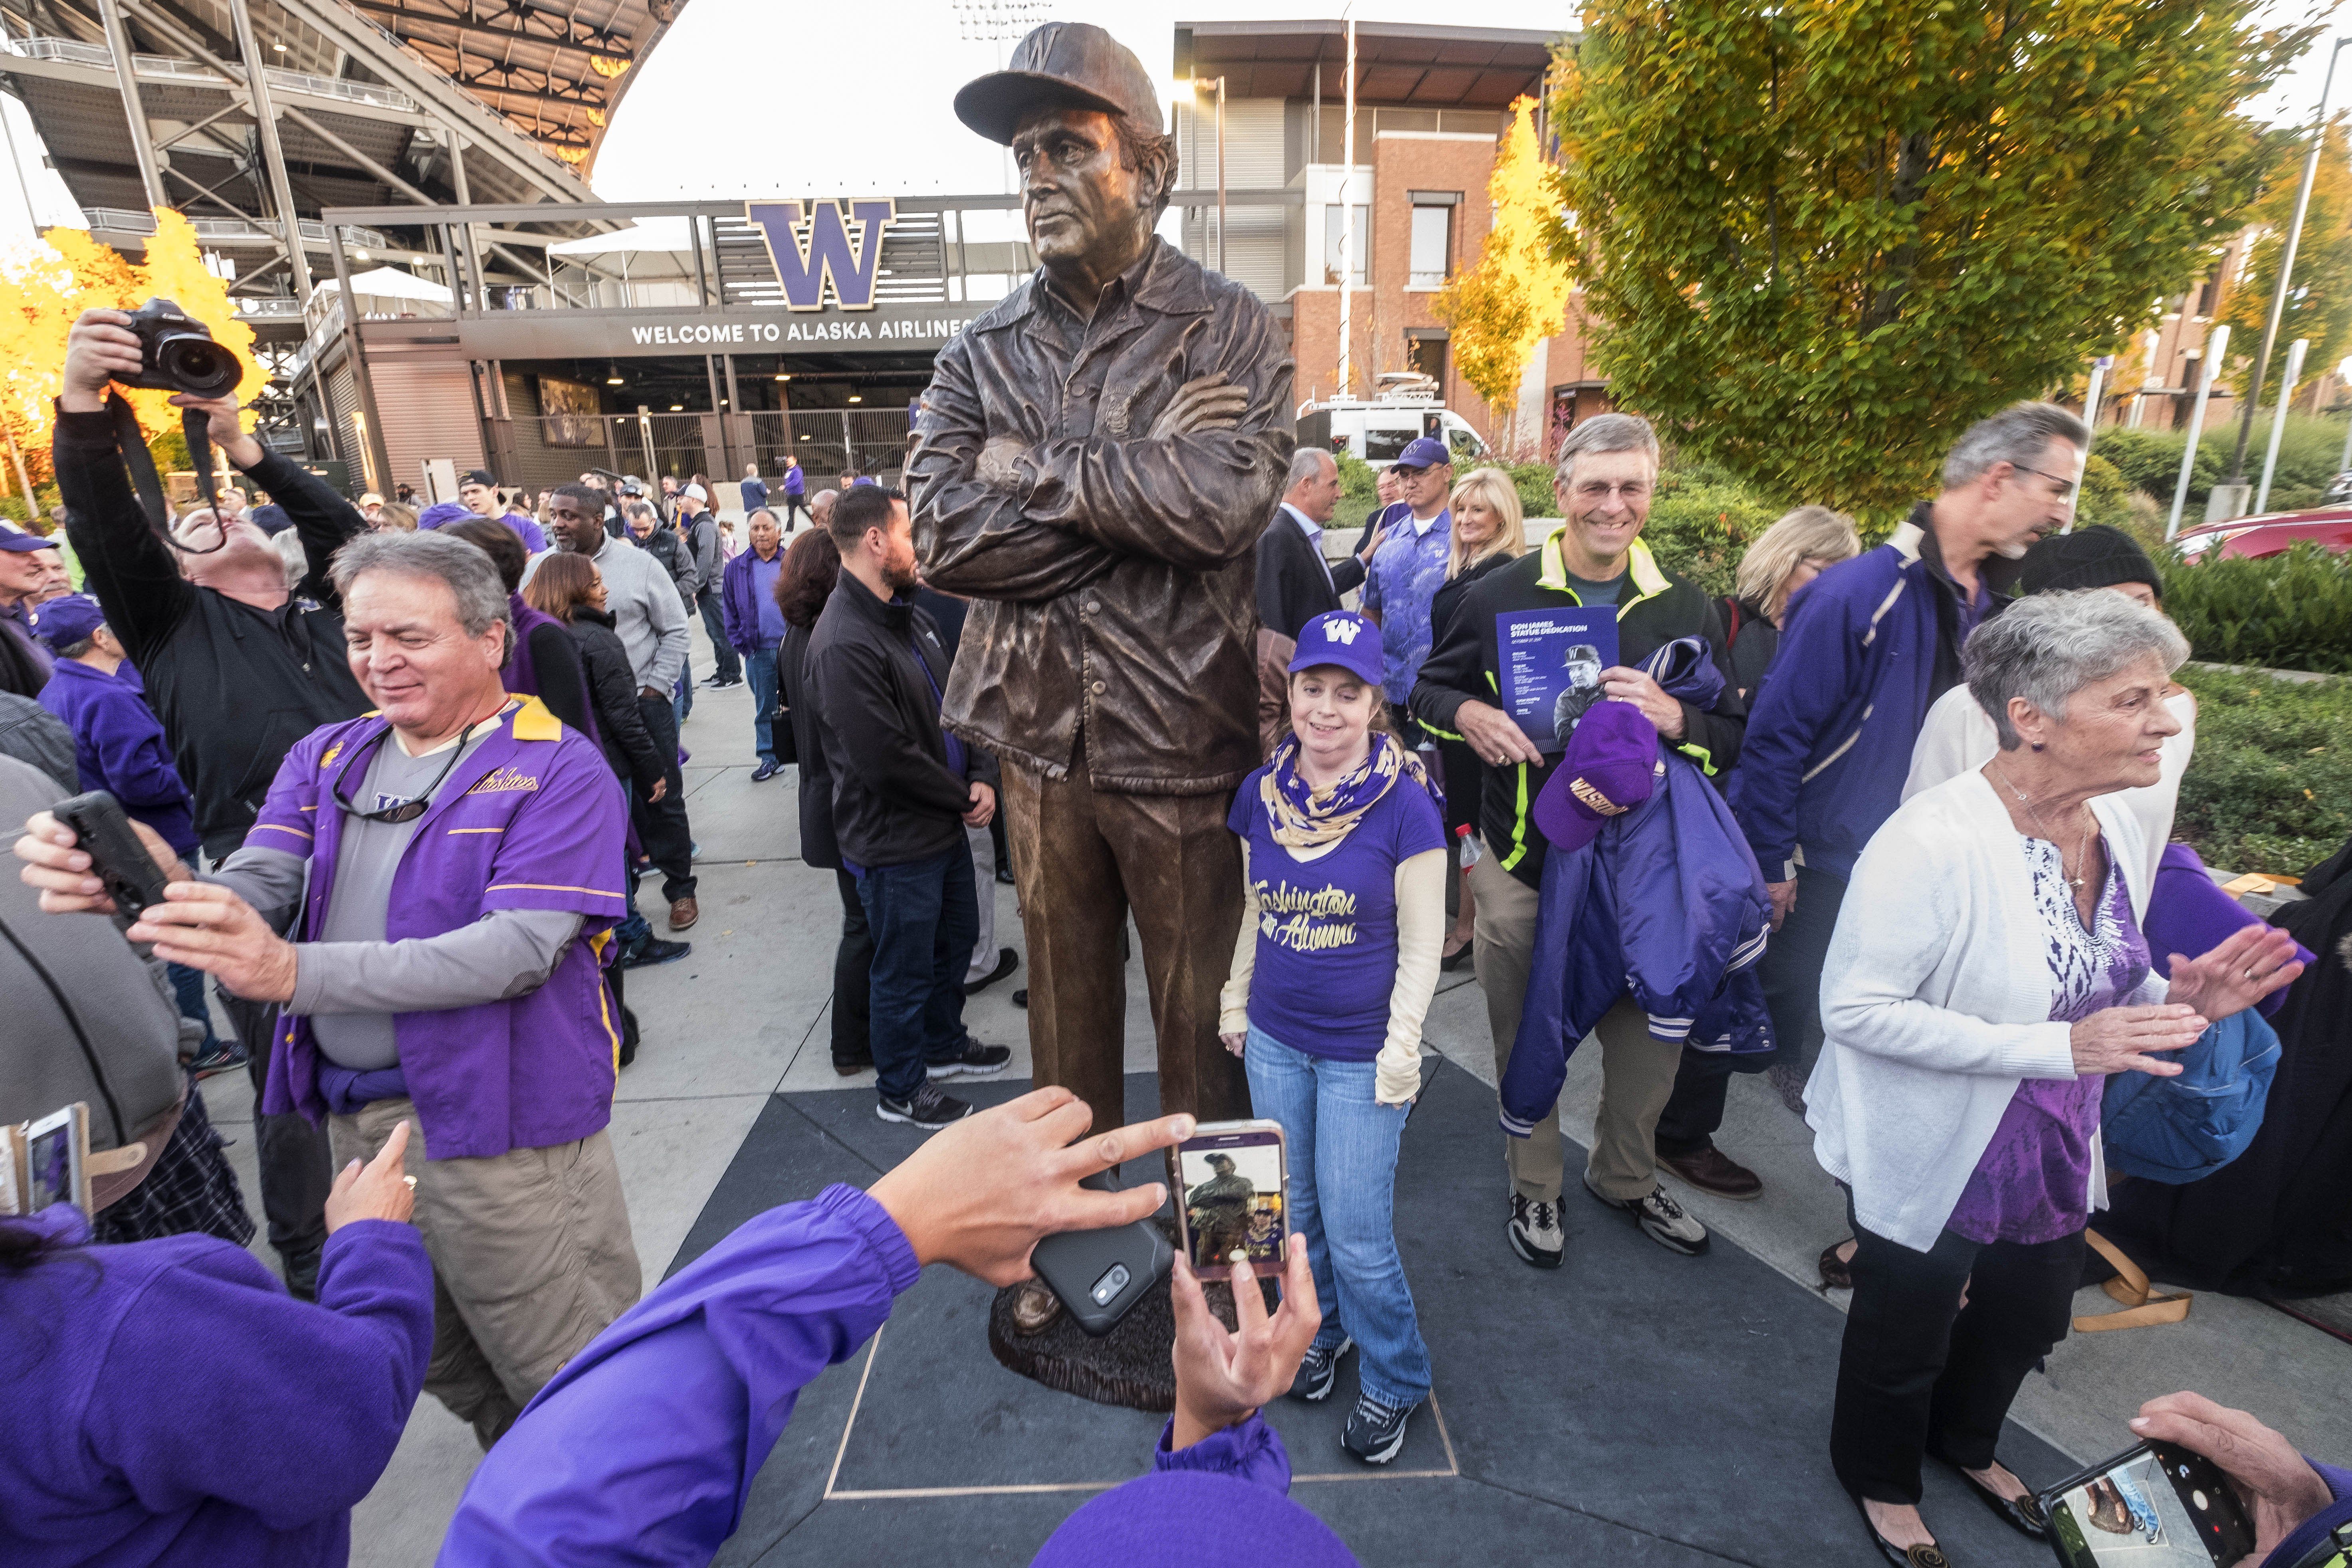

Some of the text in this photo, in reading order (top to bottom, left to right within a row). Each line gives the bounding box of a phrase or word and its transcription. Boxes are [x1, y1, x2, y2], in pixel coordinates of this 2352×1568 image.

[745, 198, 897, 311] W
[632, 324, 744, 344] WELCOME
[749, 323, 780, 342] TO
[787, 321, 872, 341] ALASKA
[1322, 619, 1361, 645] W
[1510, 620, 1554, 631] DON JAMES
[1510, 624, 1588, 638] STATUE DEDICATION
